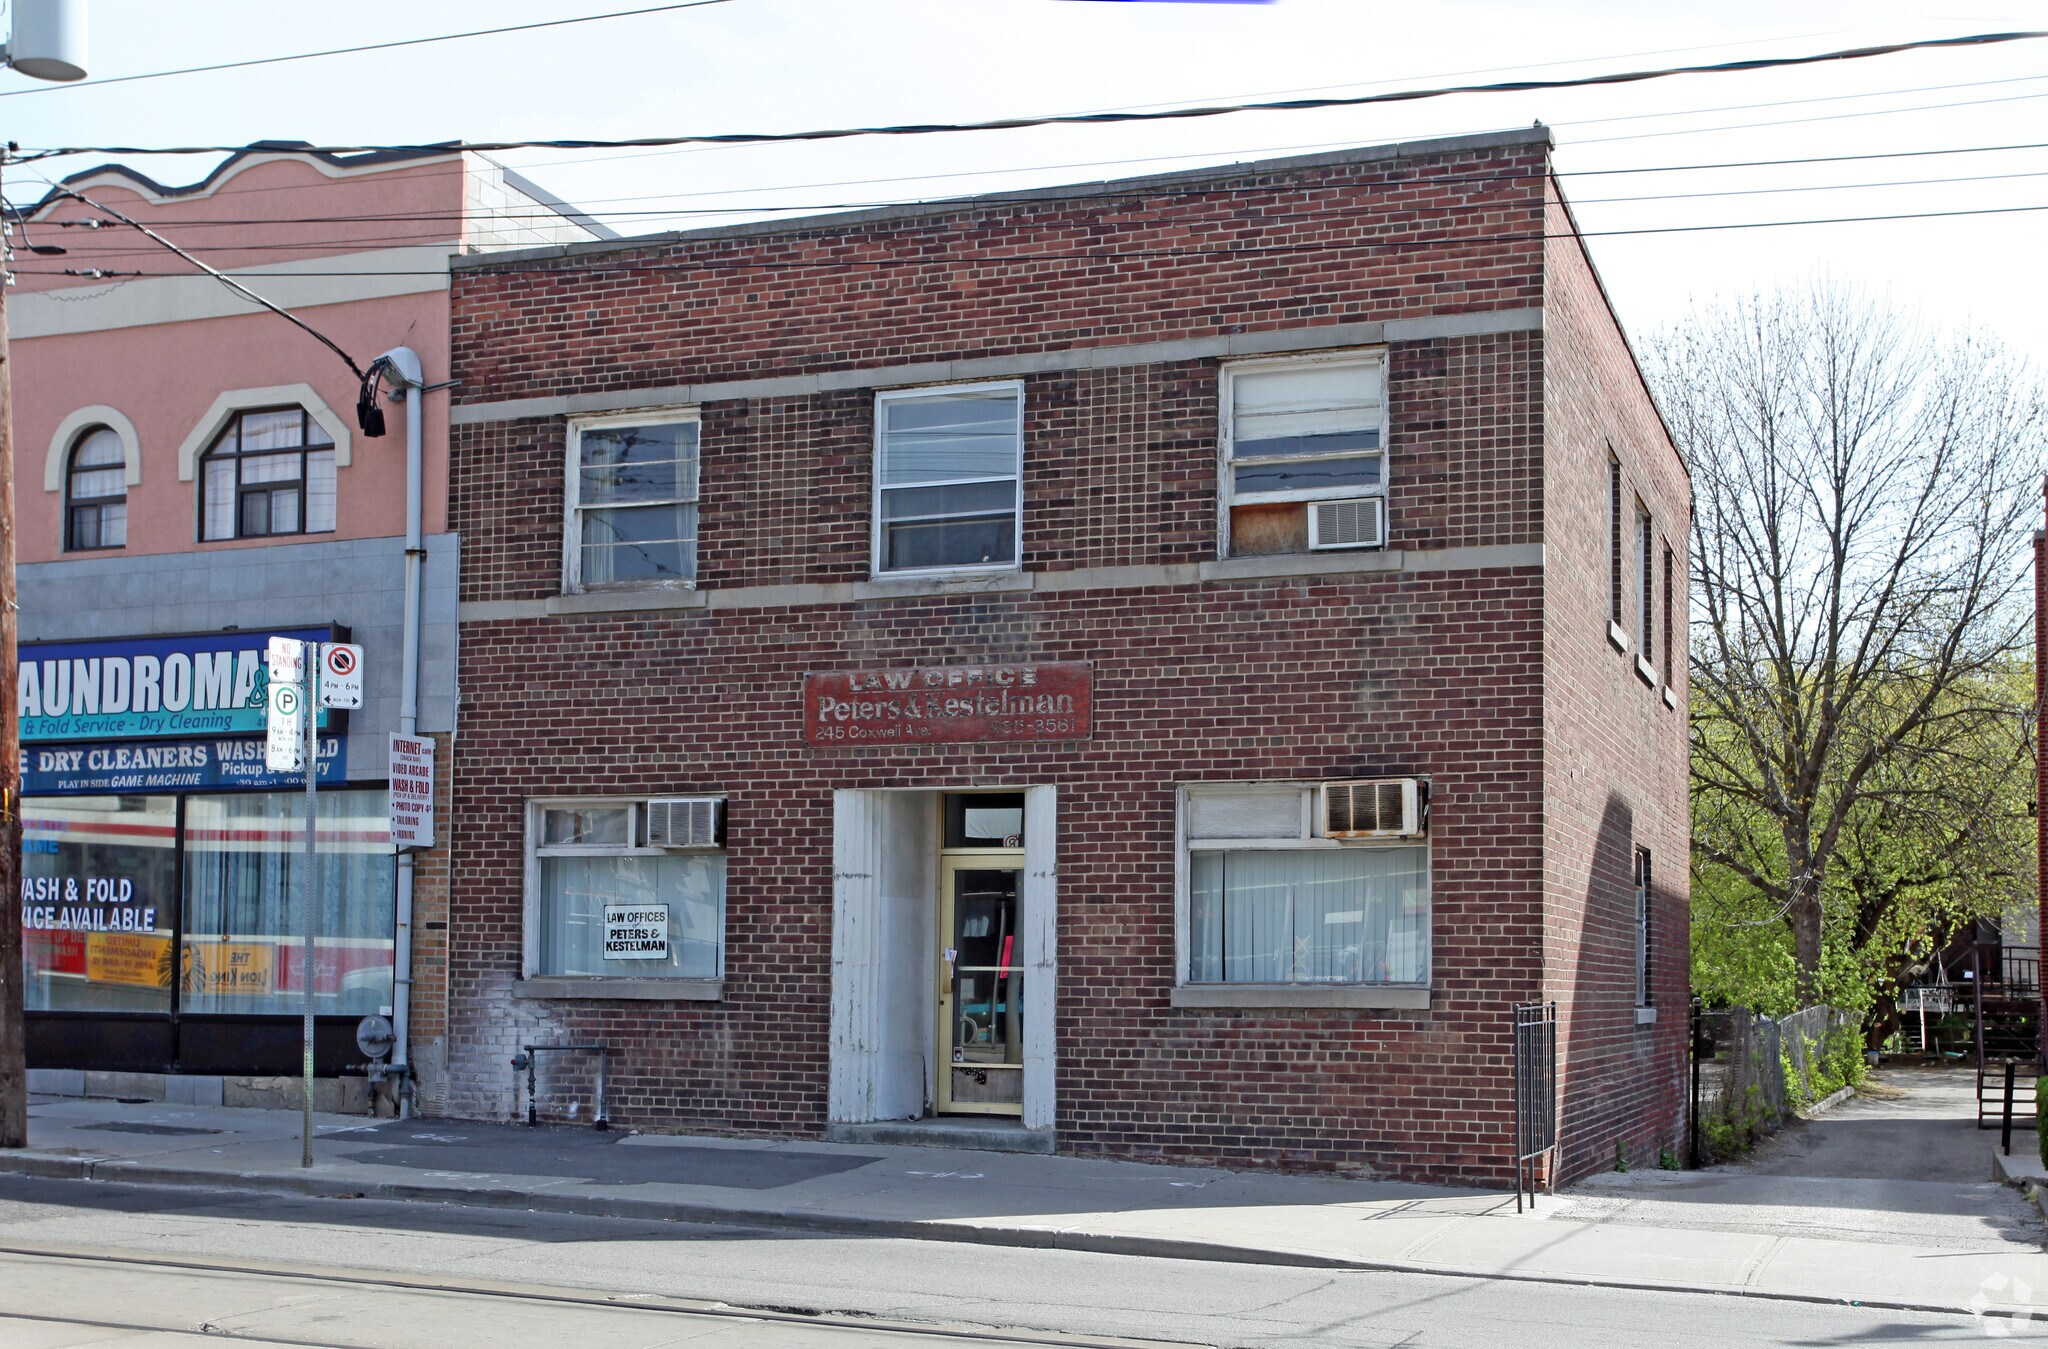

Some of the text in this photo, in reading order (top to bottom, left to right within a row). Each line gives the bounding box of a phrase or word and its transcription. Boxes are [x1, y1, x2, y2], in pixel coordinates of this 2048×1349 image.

[282, 643, 290, 655] NO
[272, 654, 302, 669] STANDING
[18, 649, 270, 718] AUNDROMA
[850, 667, 1037, 691] LAW OFFICE
[817, 690, 1074, 722] Peters & Kestelman
[25, 720, 34, 735] &
[39, 719, 70, 735] Fold
[74, 716, 125, 733] Service
[140, 715, 165, 733] Dry
[170, 712, 232, 731] Cleaning
[816, 725, 844, 740] 245
[393, 739, 421, 755] INTERNET
[39, 750, 84, 772] DRY
[88, 745, 208, 771] CLEANERS
[222, 762, 263, 777] Pickup
[393, 763, 429, 777] VIDEO ARCADE
[58, 773, 202, 789] PLAY IN SIDE GAME MACHINE
[393, 778, 408, 792] WASH
[416, 781, 429, 794] FOLD
[396, 802, 410, 811] PHOTO
[412, 803, 424, 813] COPY
[22, 837, 59, 853] AME
[64, 877, 79, 901] &
[86, 878, 132, 902] FOLD
[59, 907, 155, 931] AVAILABLE
[607, 911, 665, 923] LAW OFFICES
[610, 928, 660, 939] PETERS &
[606, 940, 665, 952] KESTELMAN
